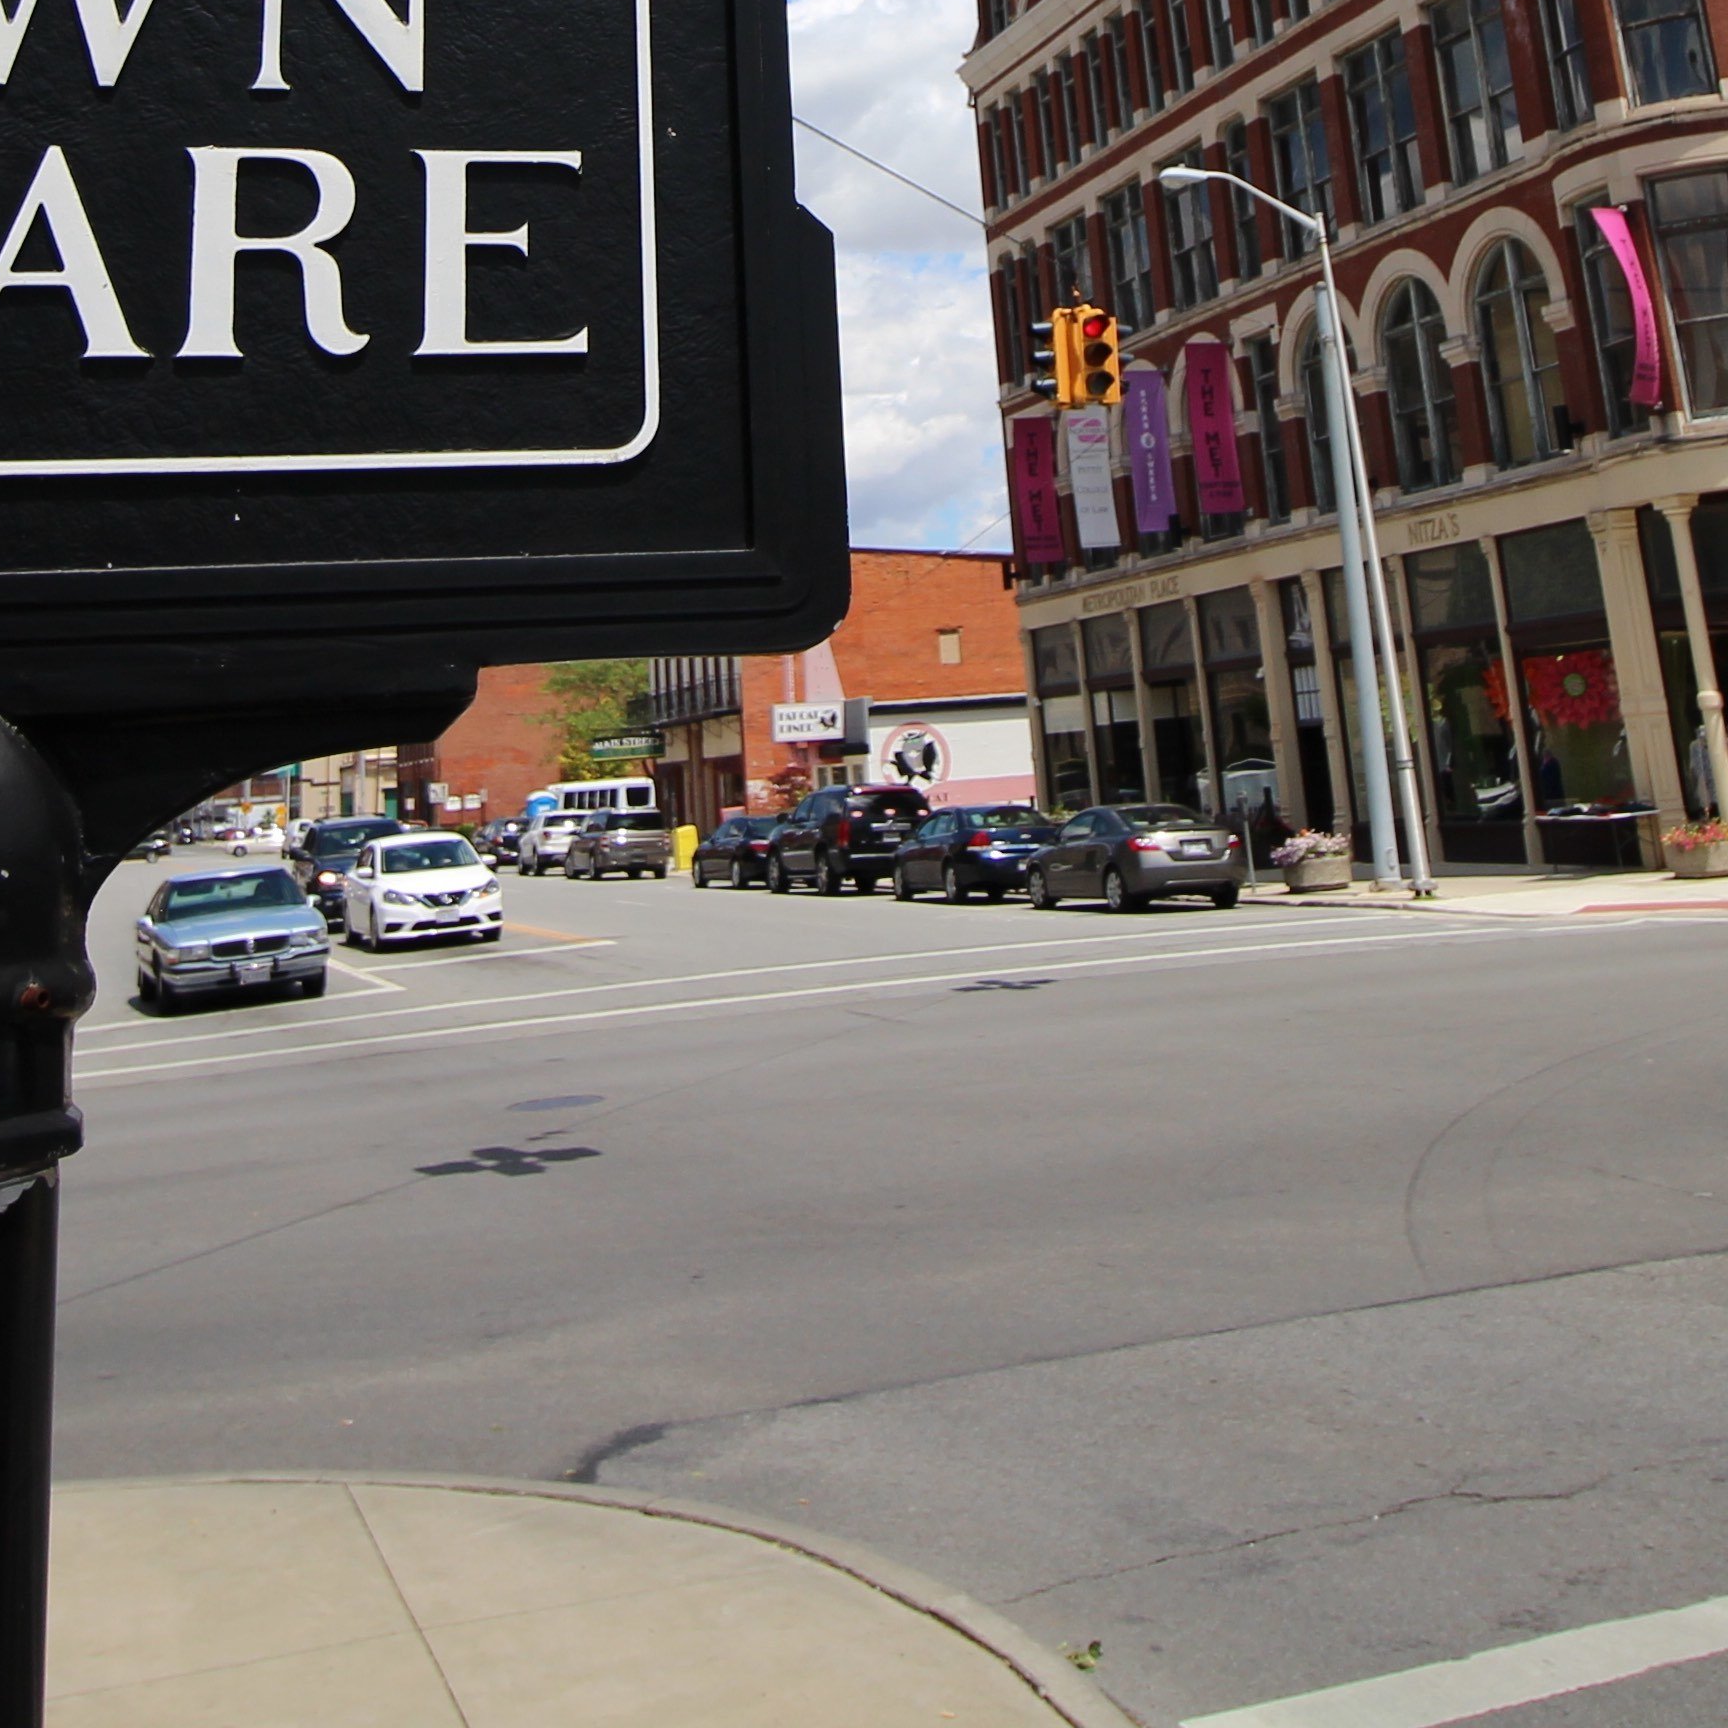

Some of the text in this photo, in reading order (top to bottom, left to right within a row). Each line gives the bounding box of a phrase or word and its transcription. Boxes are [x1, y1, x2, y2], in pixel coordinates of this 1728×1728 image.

[1200, 368, 1216, 417] THE
[1026, 432, 1039, 477] THE
[1205, 432, 1222, 478] MET
[1028, 489, 1043, 532] MET
[1408, 512, 1462, 546] NITZA'S
[779, 710, 819, 722] FAT CAT
[779, 723, 813, 734] DINER
